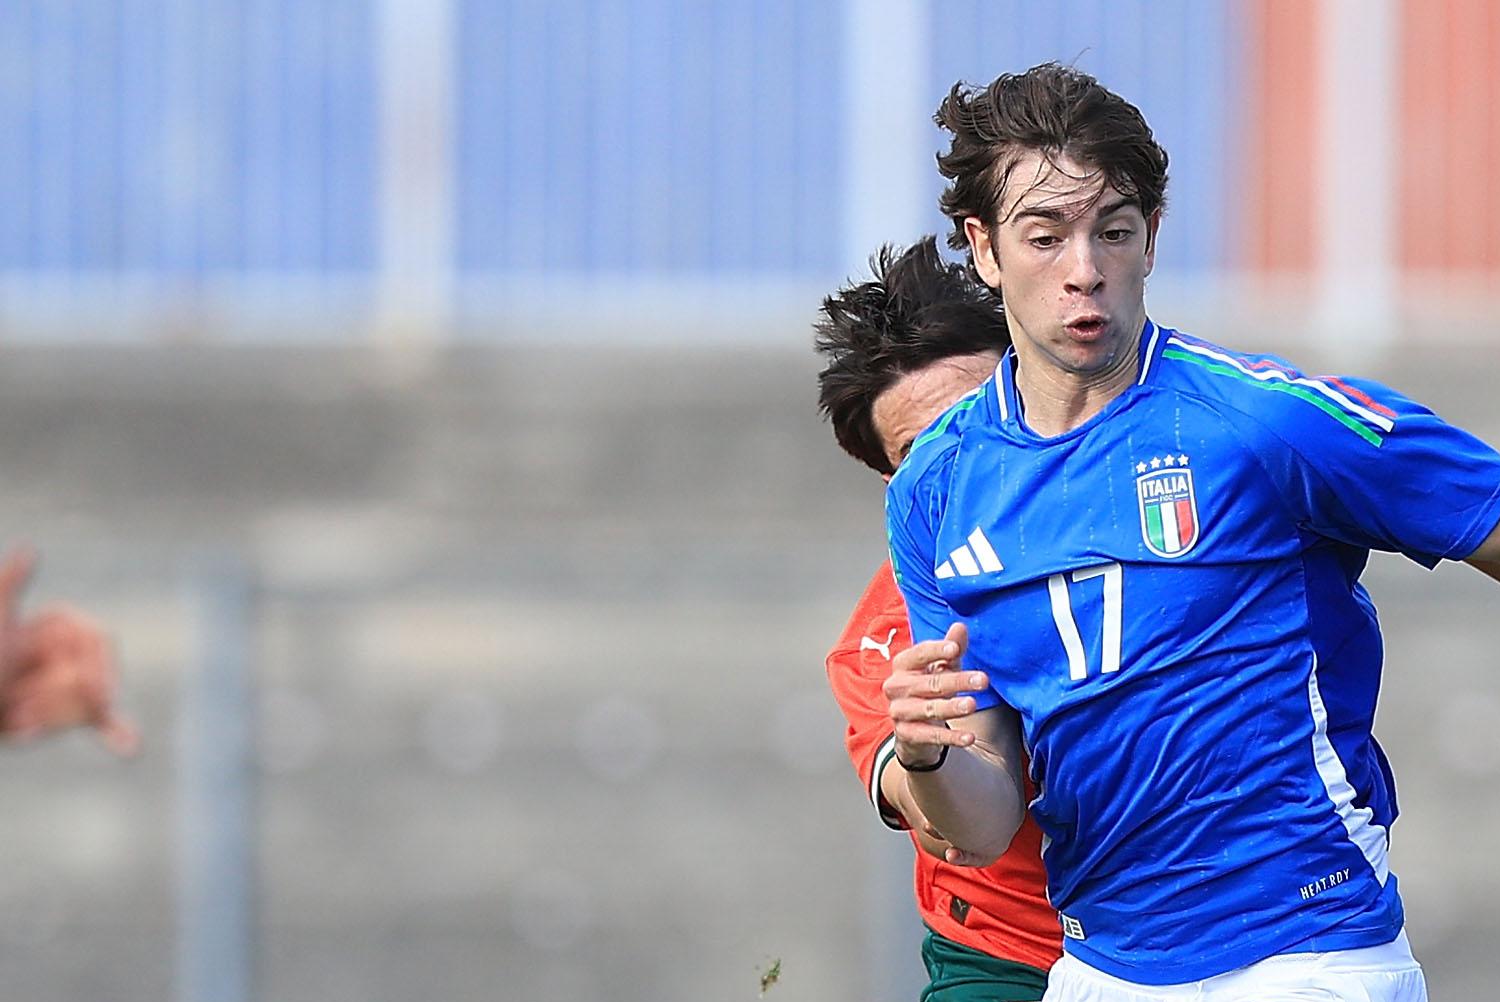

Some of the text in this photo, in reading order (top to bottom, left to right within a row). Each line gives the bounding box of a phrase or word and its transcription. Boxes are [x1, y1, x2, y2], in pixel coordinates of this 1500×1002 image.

[1142, 476, 1188, 498] ITALIA
[1048, 563, 1122, 681] 17
[1300, 868, 1350, 900] HEAT.RDY
